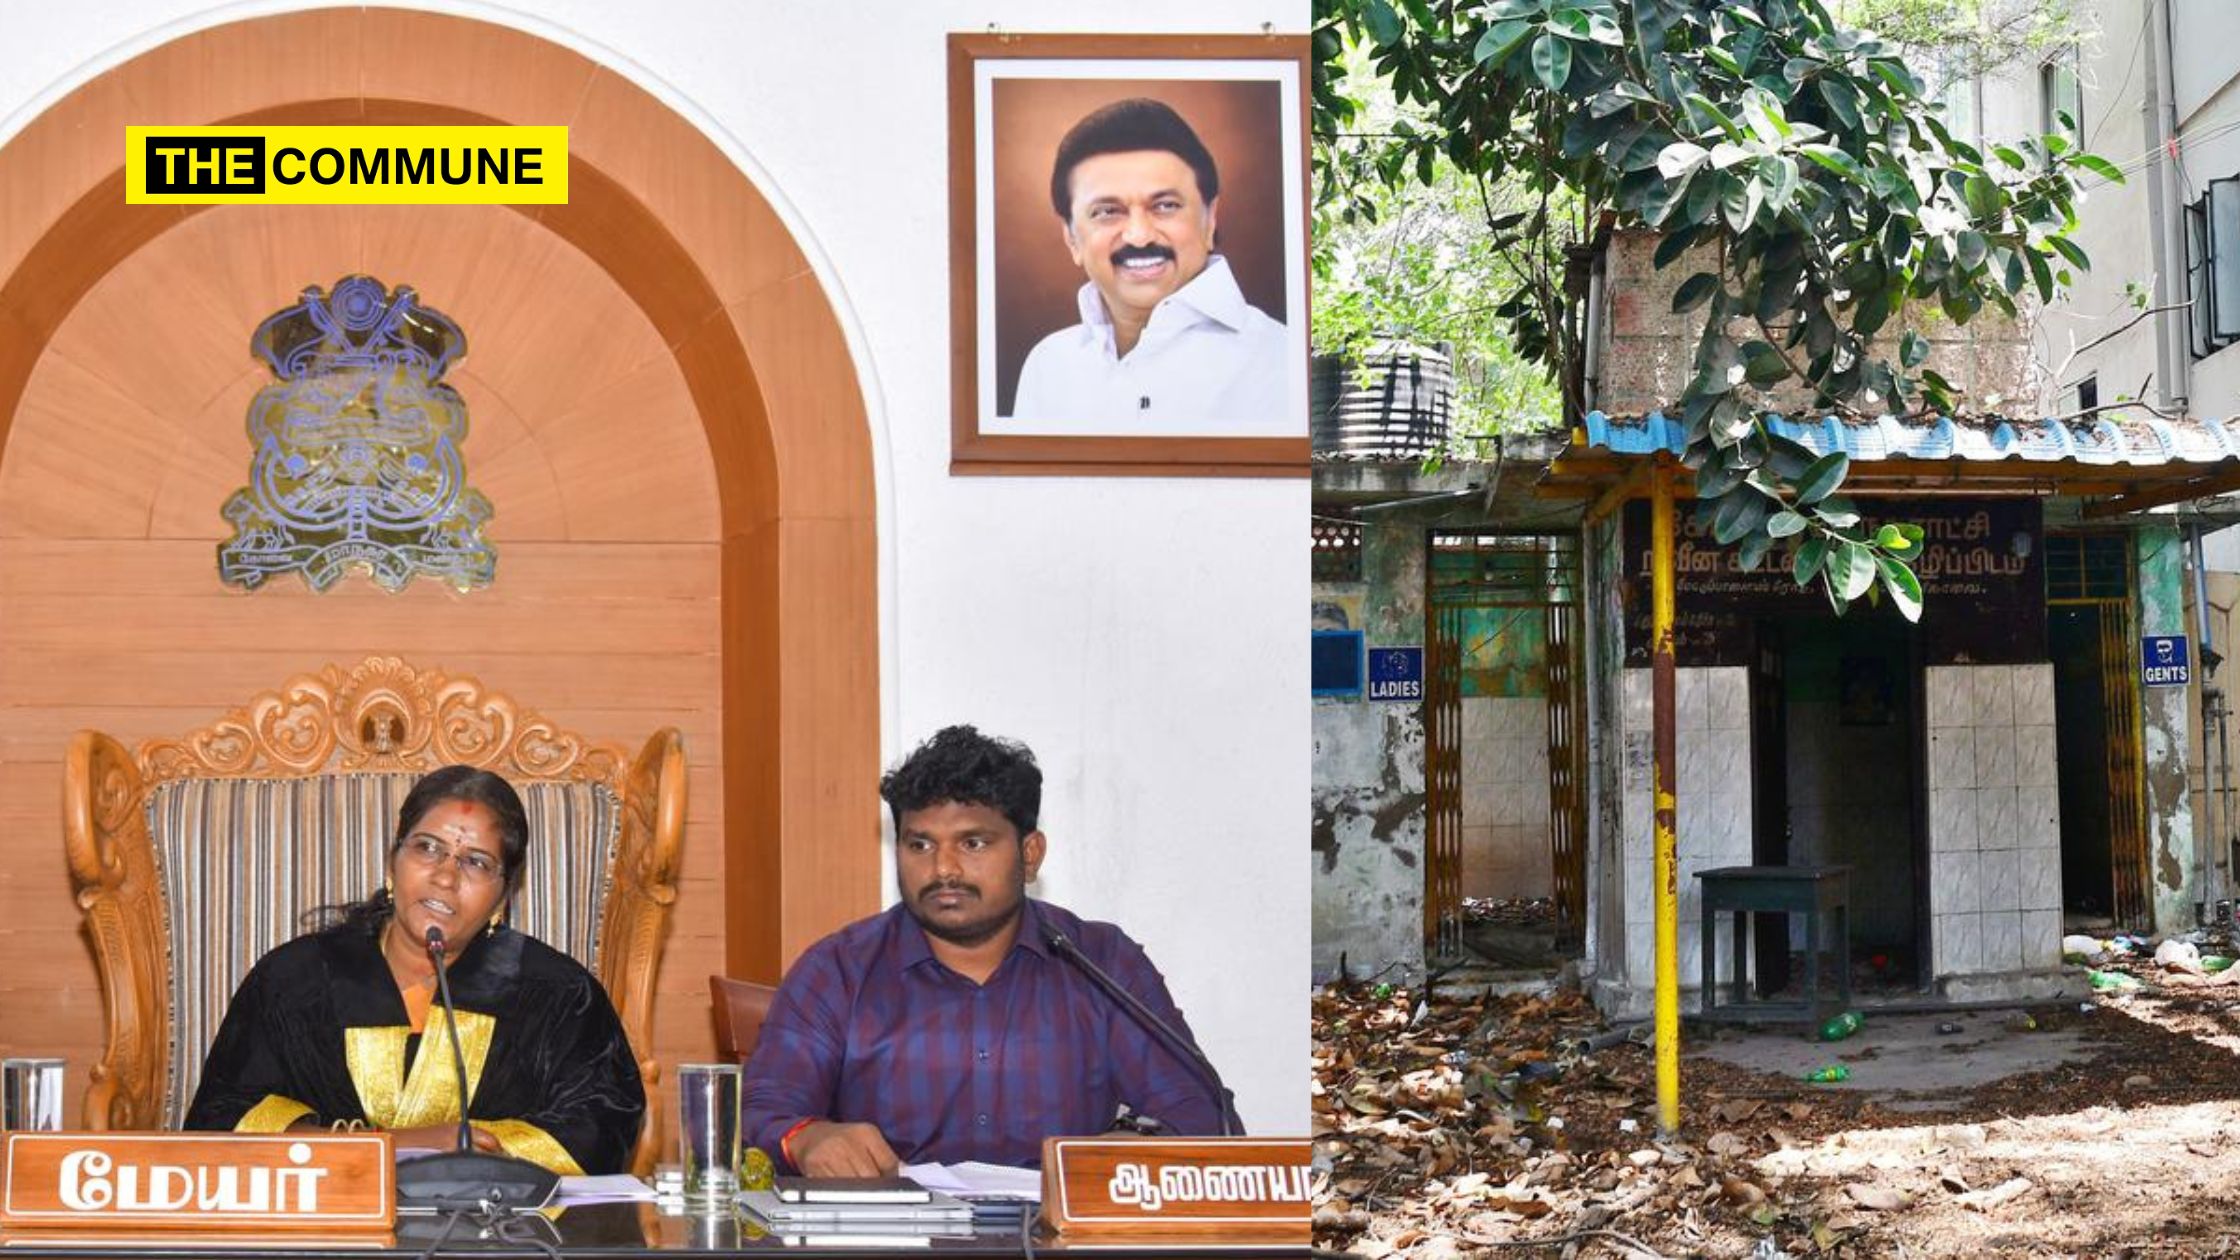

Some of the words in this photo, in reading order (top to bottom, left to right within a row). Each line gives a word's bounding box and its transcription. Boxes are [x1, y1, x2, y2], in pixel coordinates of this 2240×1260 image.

[2145, 666, 2188, 682] GENTS
[1370, 680, 1420, 697] LADIES
[59, 1142, 328, 1212] மேயர்
